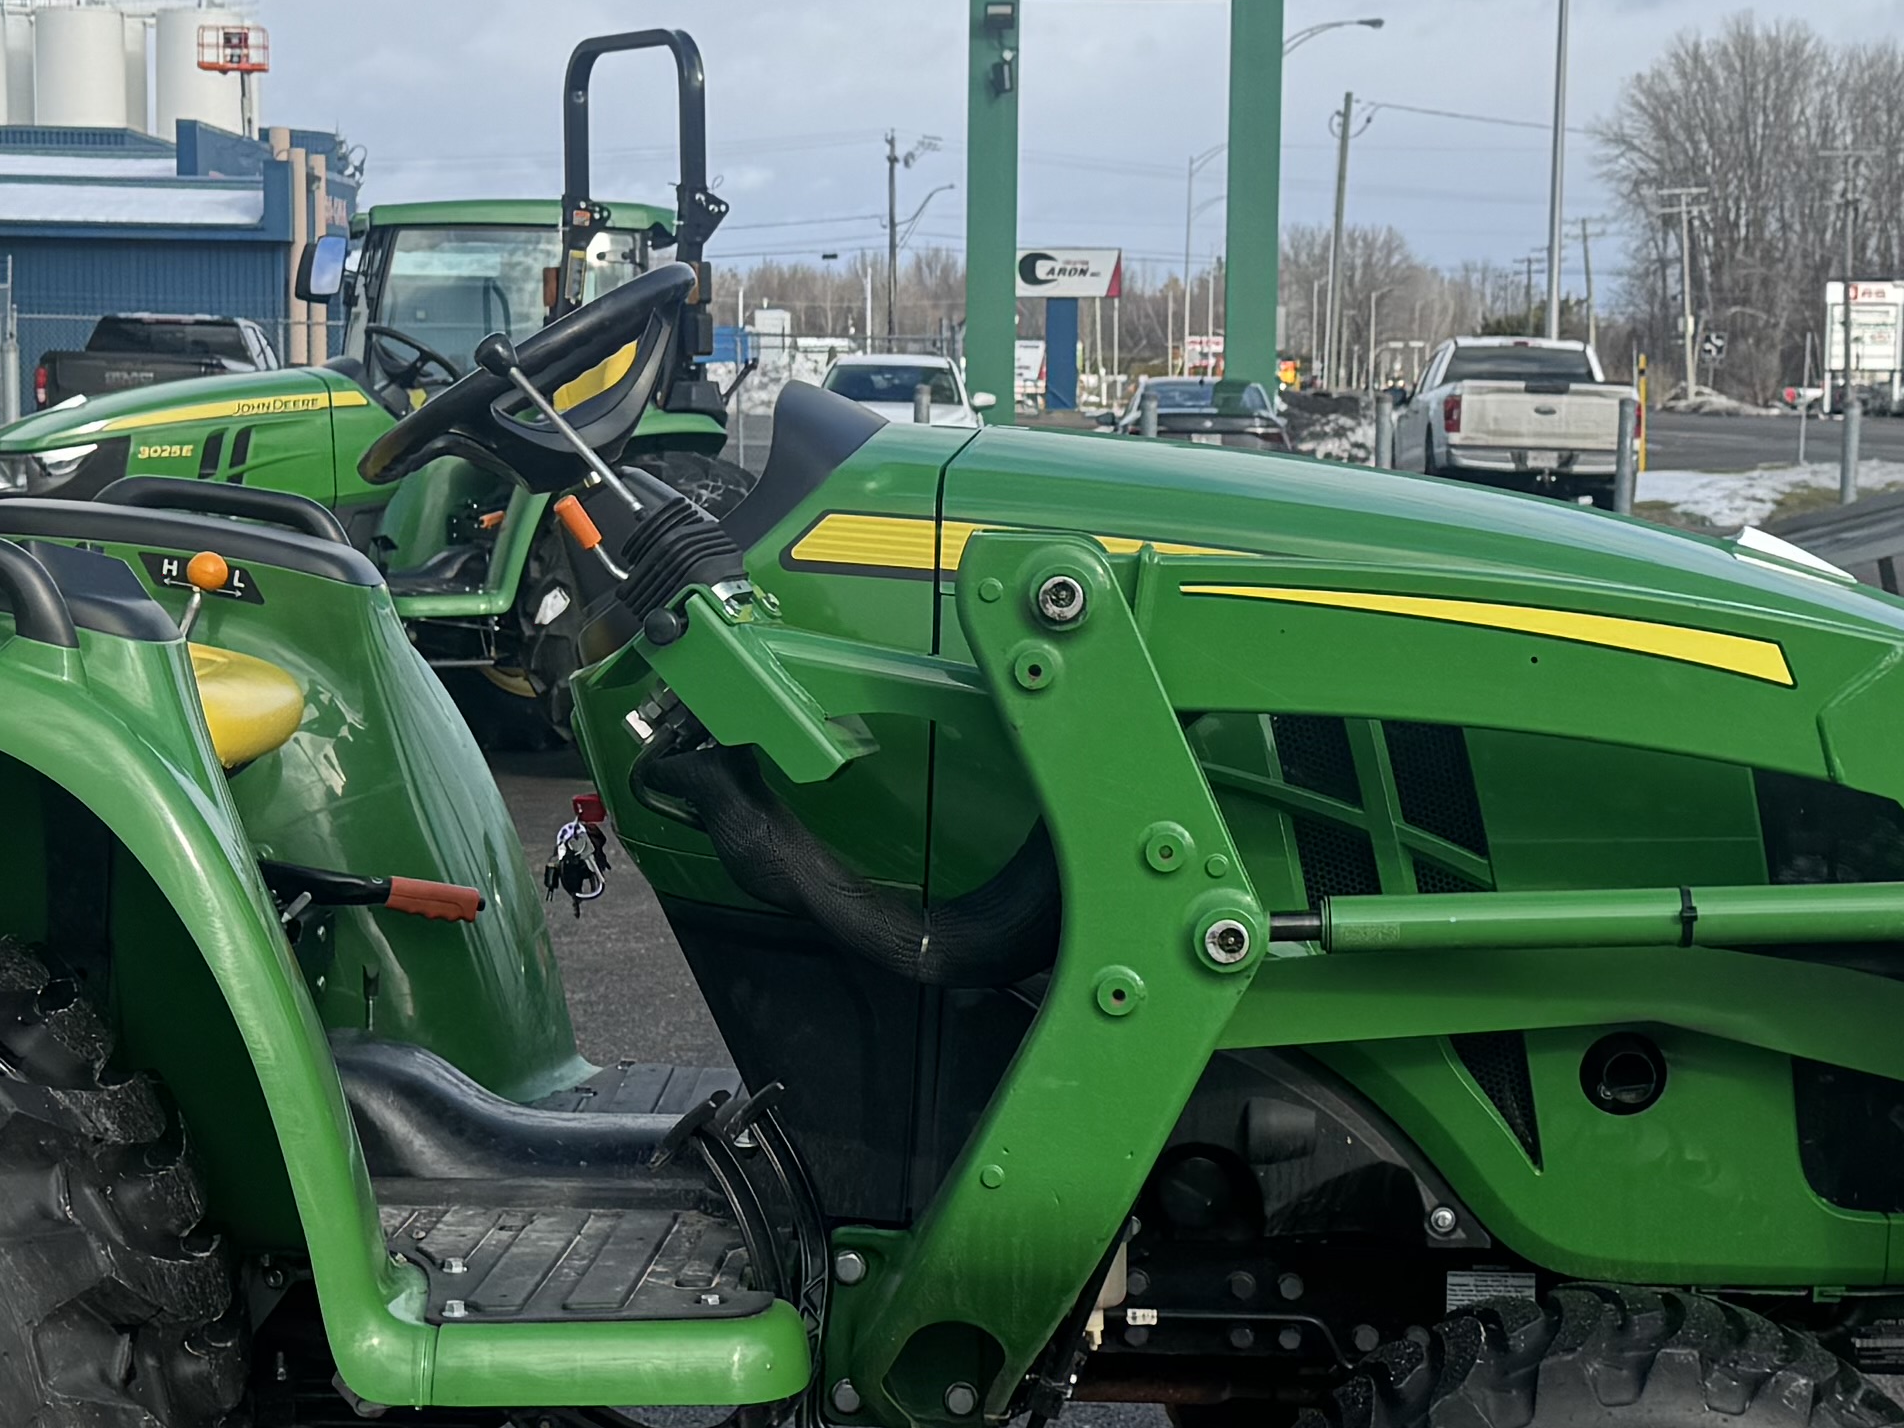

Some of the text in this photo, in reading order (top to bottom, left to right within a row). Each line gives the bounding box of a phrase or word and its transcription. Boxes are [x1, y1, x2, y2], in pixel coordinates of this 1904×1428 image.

[232, 398, 319, 417] JOHN DEERE
[138, 444, 194, 459] 3025E
[162, 558, 245, 588] H L
